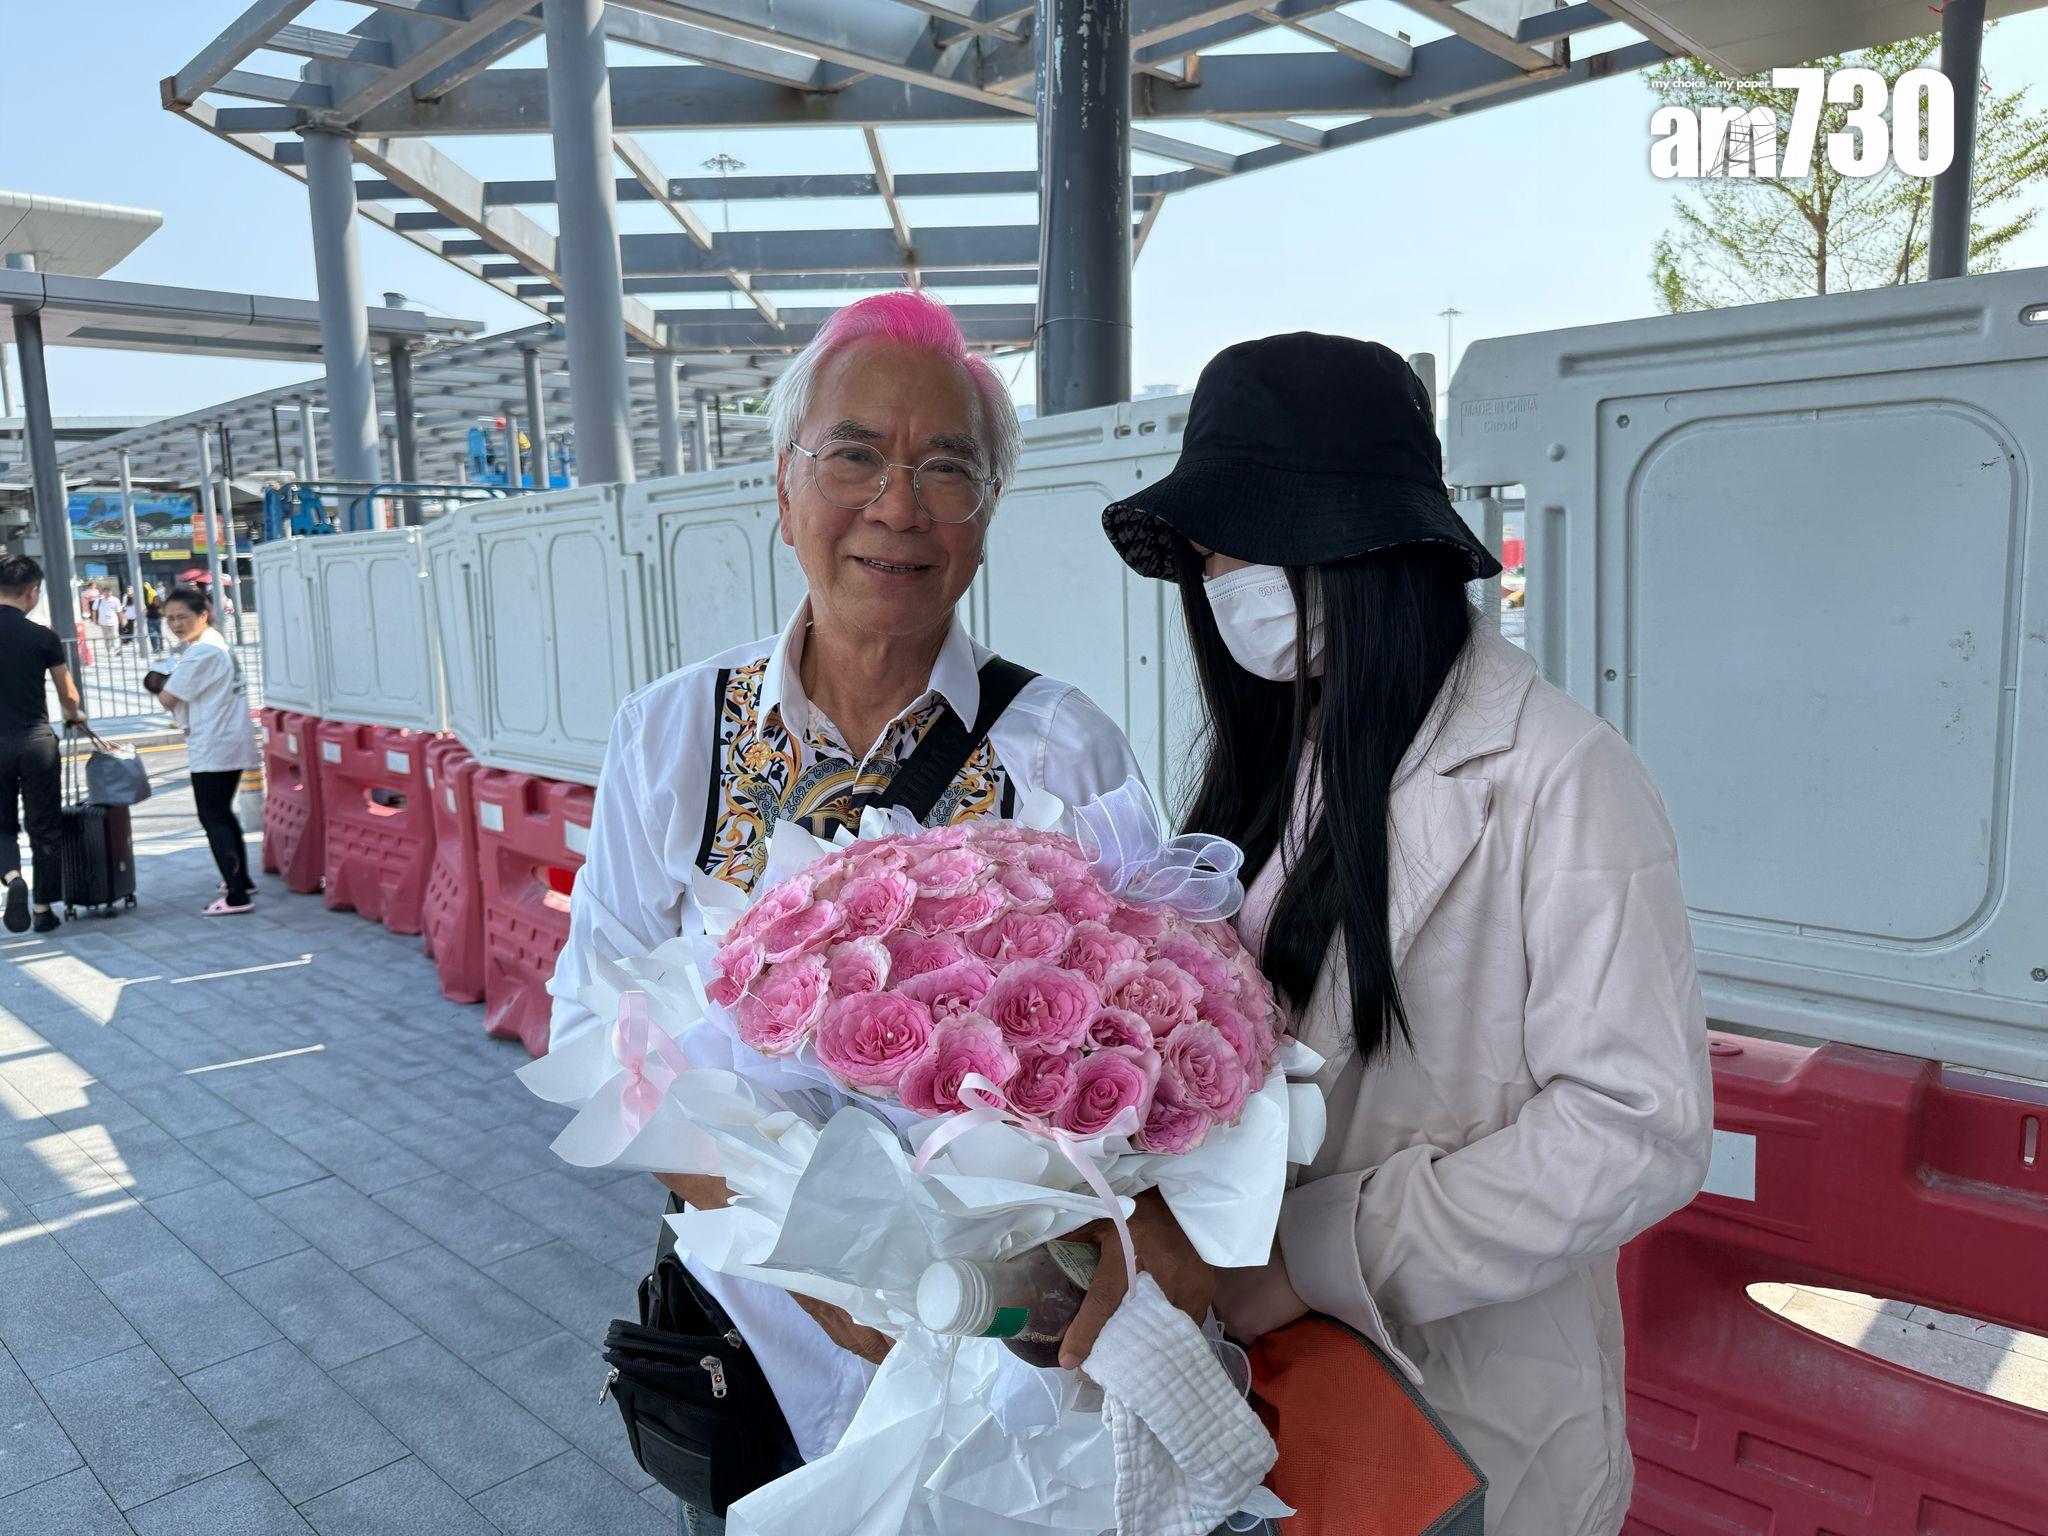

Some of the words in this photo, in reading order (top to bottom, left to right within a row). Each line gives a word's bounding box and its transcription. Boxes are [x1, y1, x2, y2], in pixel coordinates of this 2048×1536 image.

[1464, 401, 1491, 416] MADE
[1494, 400, 1504, 414] IN
[1506, 397, 1537, 413] CHINA
